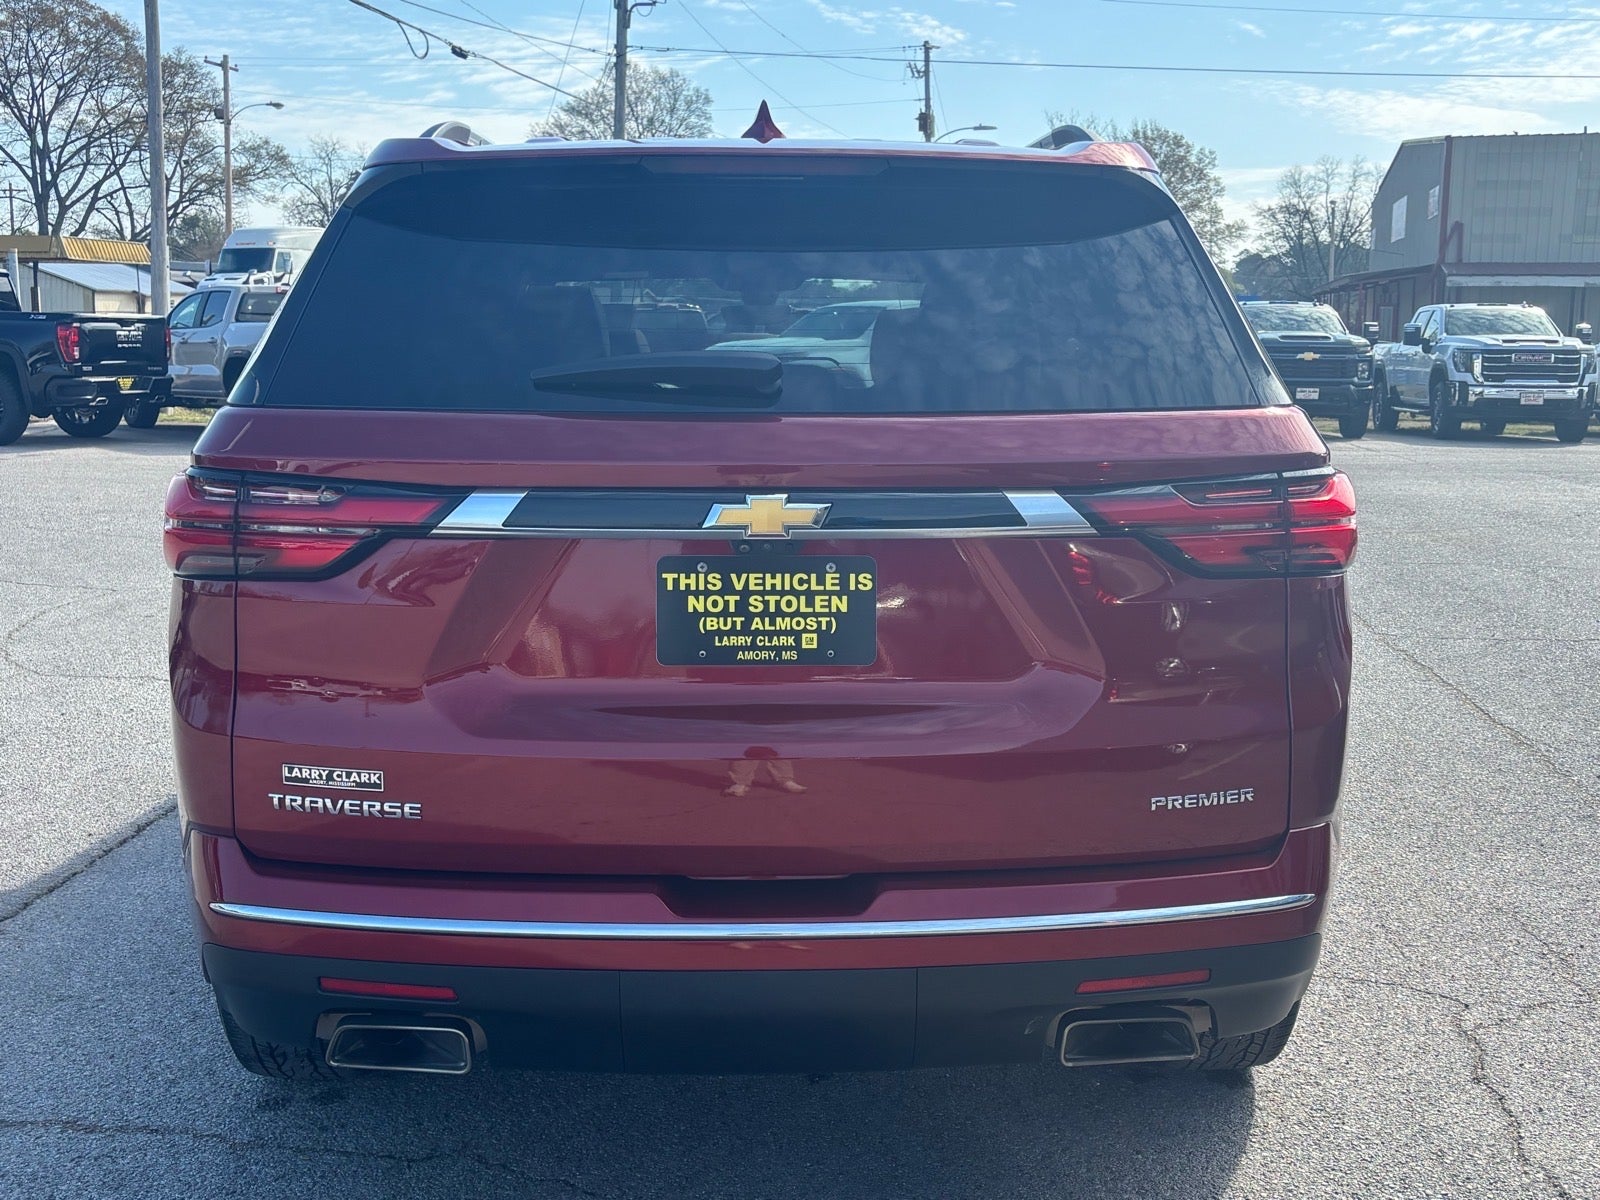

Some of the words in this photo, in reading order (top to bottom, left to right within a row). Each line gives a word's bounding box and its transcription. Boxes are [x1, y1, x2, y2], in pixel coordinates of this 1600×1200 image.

[661, 573, 722, 590] THIS
[730, 573, 840, 590] VEHICLE
[850, 573, 873, 590] IS
[687, 595, 740, 612] NOT
[748, 595, 848, 612] STOLEN
[699, 616, 745, 633] (BUT
[751, 616, 836, 633] ALMOST)
[714, 635, 752, 646] LARRY
[756, 635, 796, 646] CLARK
[736, 651, 779, 661] AMORY,
[781, 651, 798, 660] MS
[284, 766, 329, 780] LARRY
[332, 771, 381, 784] CLARK
[268, 793, 422, 819] TRAVERSE
[1150, 788, 1255, 811] PREMIER
